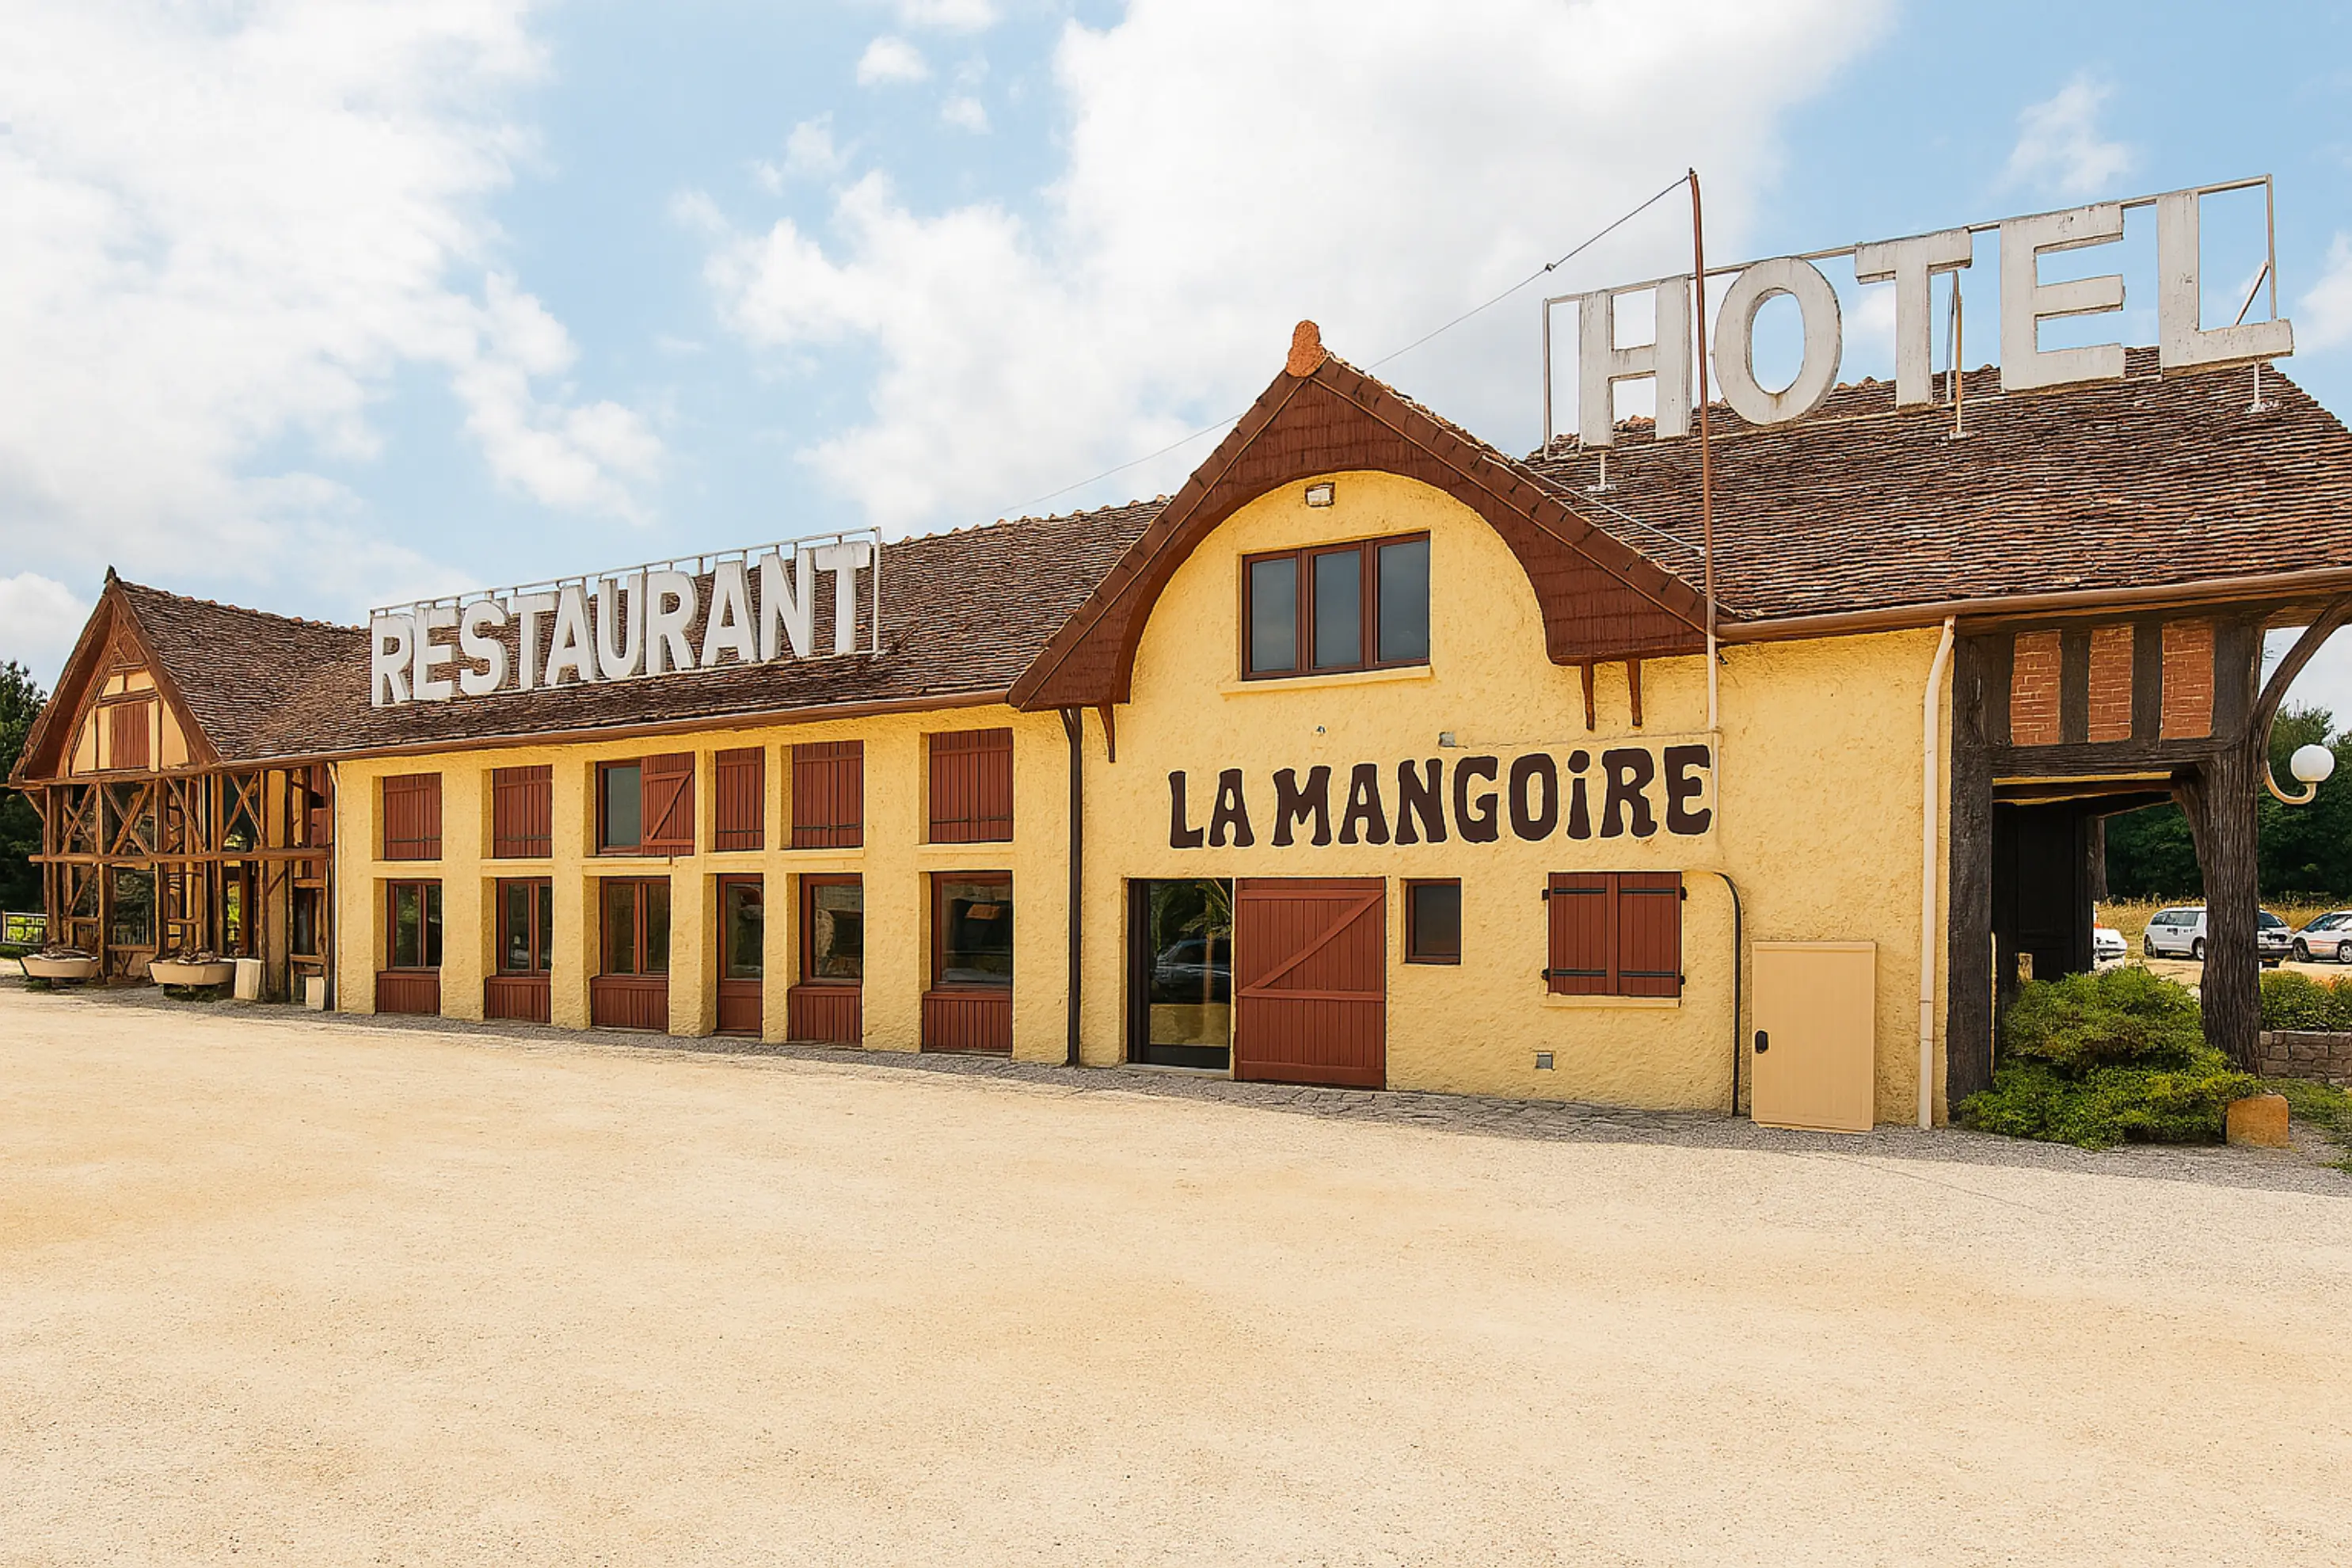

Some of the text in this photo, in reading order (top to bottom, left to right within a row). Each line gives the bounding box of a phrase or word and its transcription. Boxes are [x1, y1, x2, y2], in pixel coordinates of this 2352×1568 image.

[1579, 188, 2294, 448] HOTEL
[371, 540, 872, 707] RESTAURANT
[1168, 768, 1255, 848] LA
